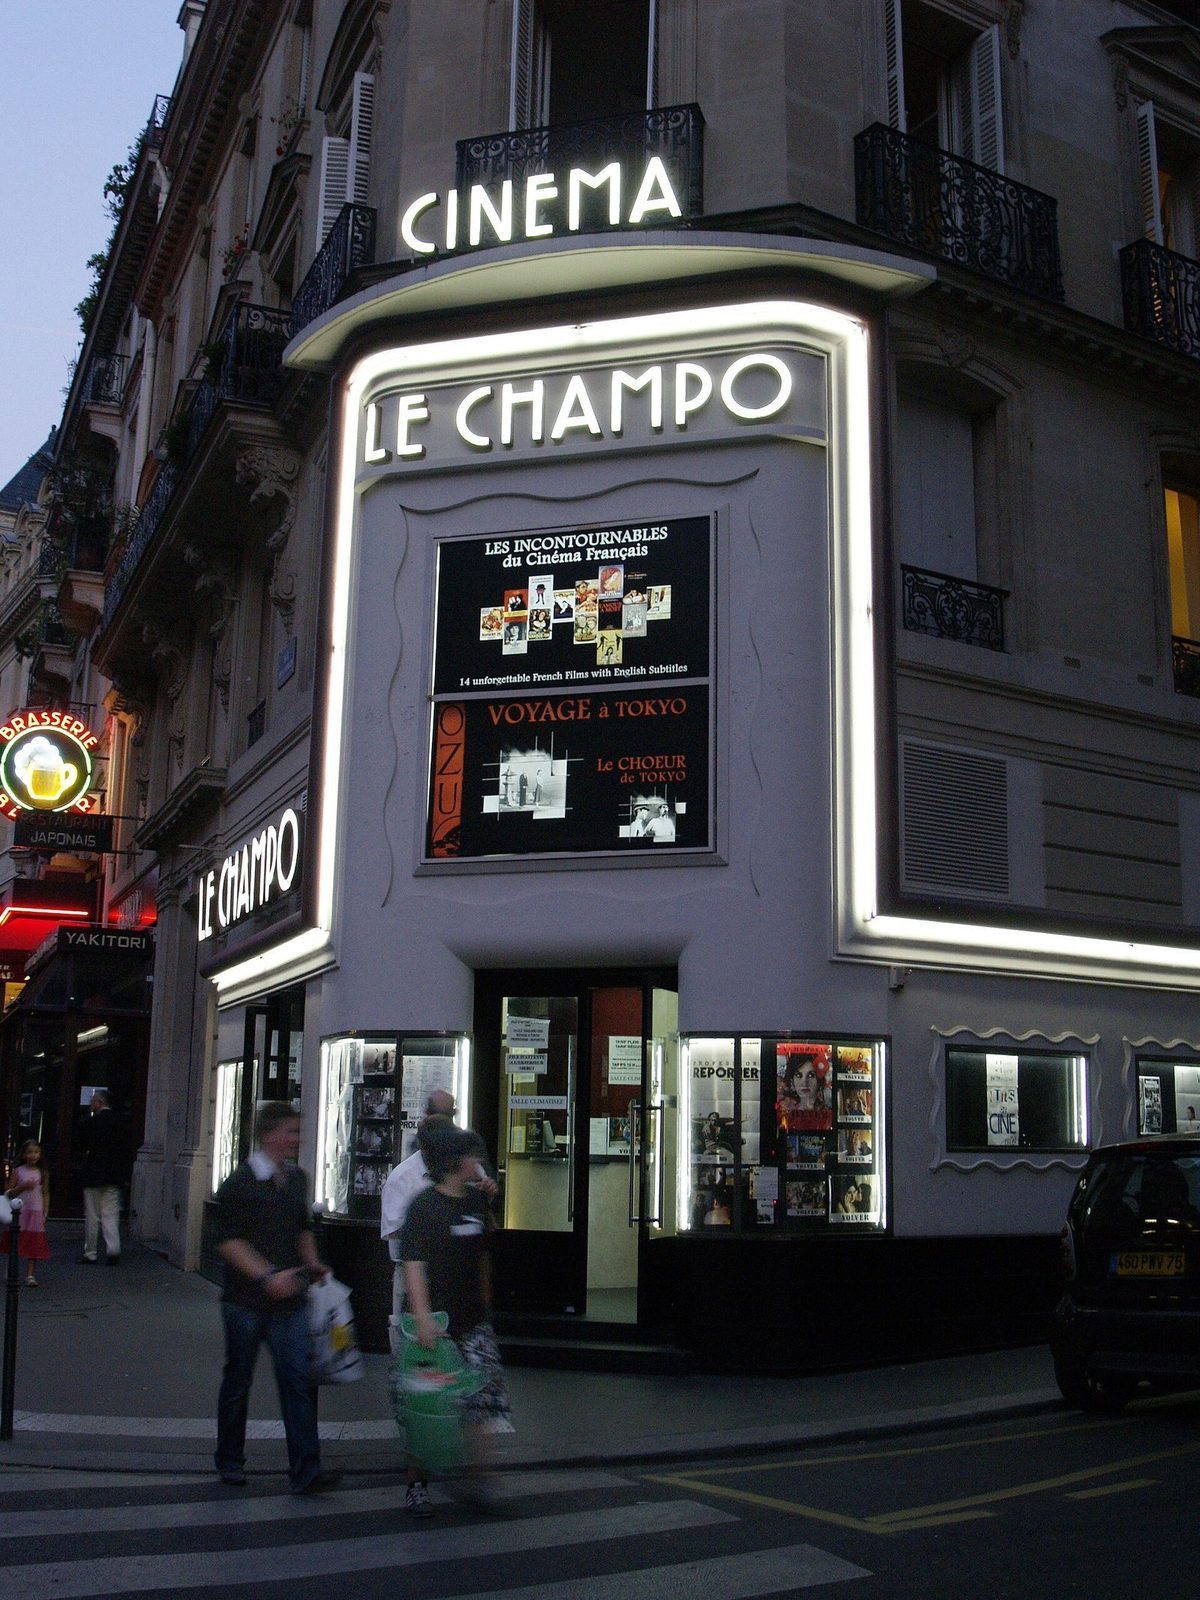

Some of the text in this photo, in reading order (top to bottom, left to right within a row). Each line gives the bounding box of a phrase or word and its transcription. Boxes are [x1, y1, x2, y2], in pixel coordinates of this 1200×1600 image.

[401, 156, 682, 255] CINEMA
[364, 353, 793, 464] LE CHAMPO
[485, 526, 668, 556] LES INCONTOURNABLES
[502, 543, 649, 569] du Cinéma Français
[459, 663, 688, 687] 14 unforgettable French Films with English Subtitles
[487, 697, 688, 726] VOYAGE à TOKYO
[0, 711, 98, 750] BRASSERIE
[438, 703, 464, 815] OZU
[597, 755, 687, 772] Le CHOEUR
[620, 770, 687, 784] de TOKYO
[30, 831, 97, 847] JAPONAIS
[198, 869, 216, 942] LE
[217, 808, 299, 928] CHAMPO
[66, 931, 147, 949] YAKITORI
[693, 1066, 760, 1079] REPORER
